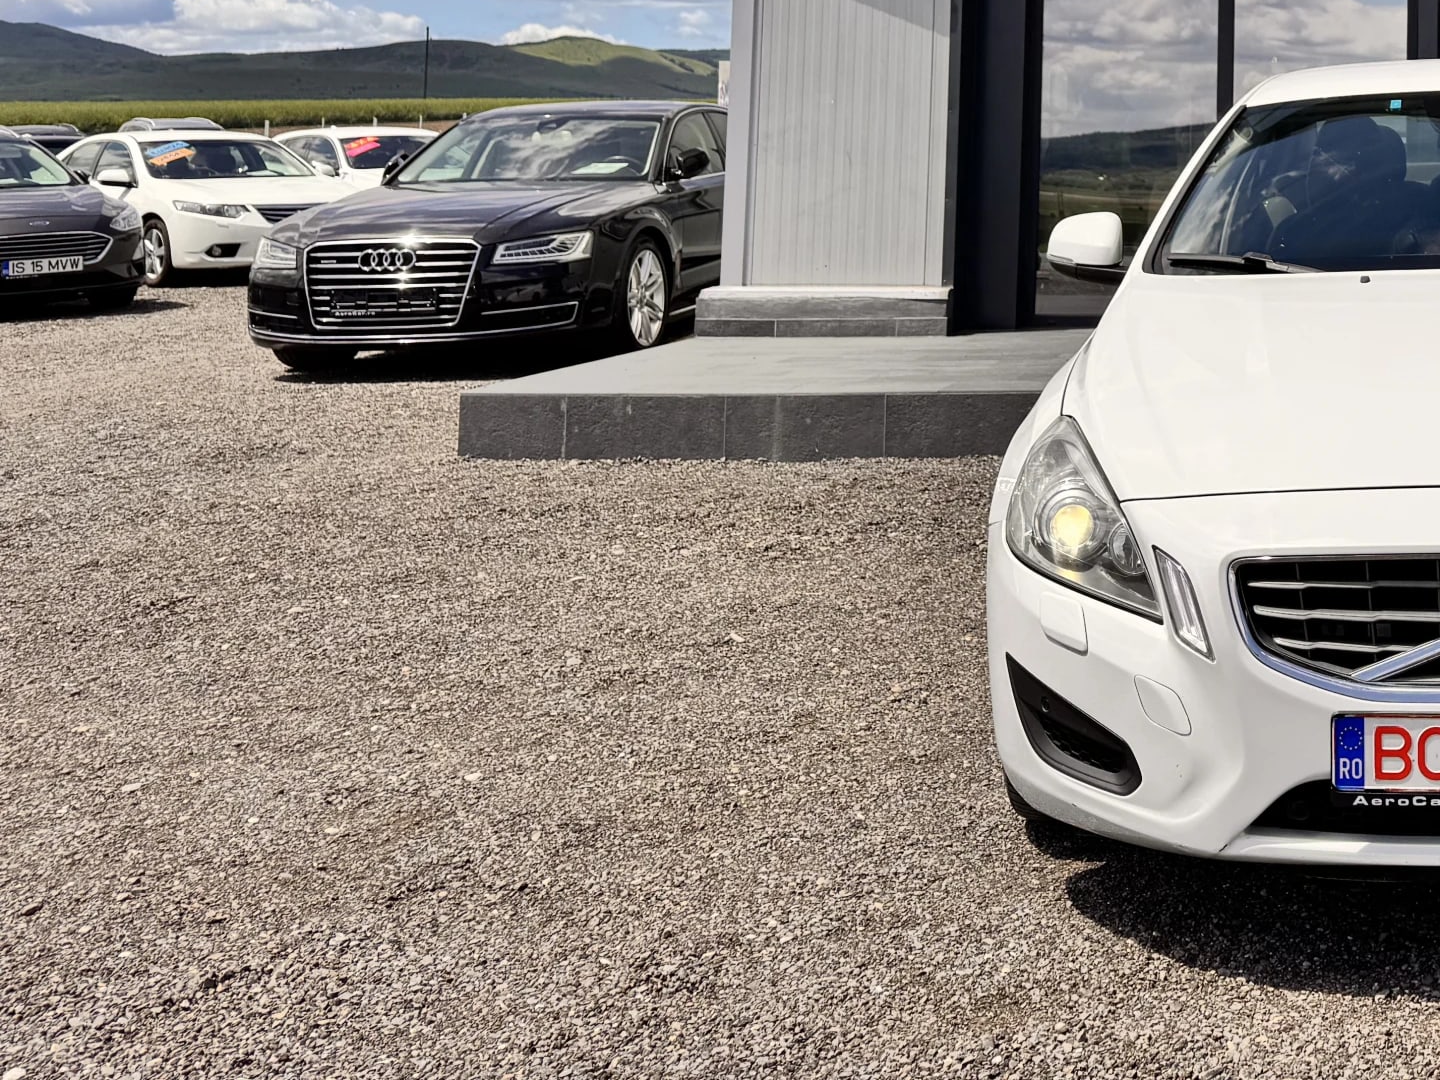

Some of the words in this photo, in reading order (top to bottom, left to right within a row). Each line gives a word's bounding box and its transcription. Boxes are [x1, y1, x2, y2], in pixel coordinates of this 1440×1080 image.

[12, 262, 25, 274] IS
[31, 260, 43, 272] 15
[48, 258, 80, 271] MVW
[1338, 757, 1363, 780] RO
